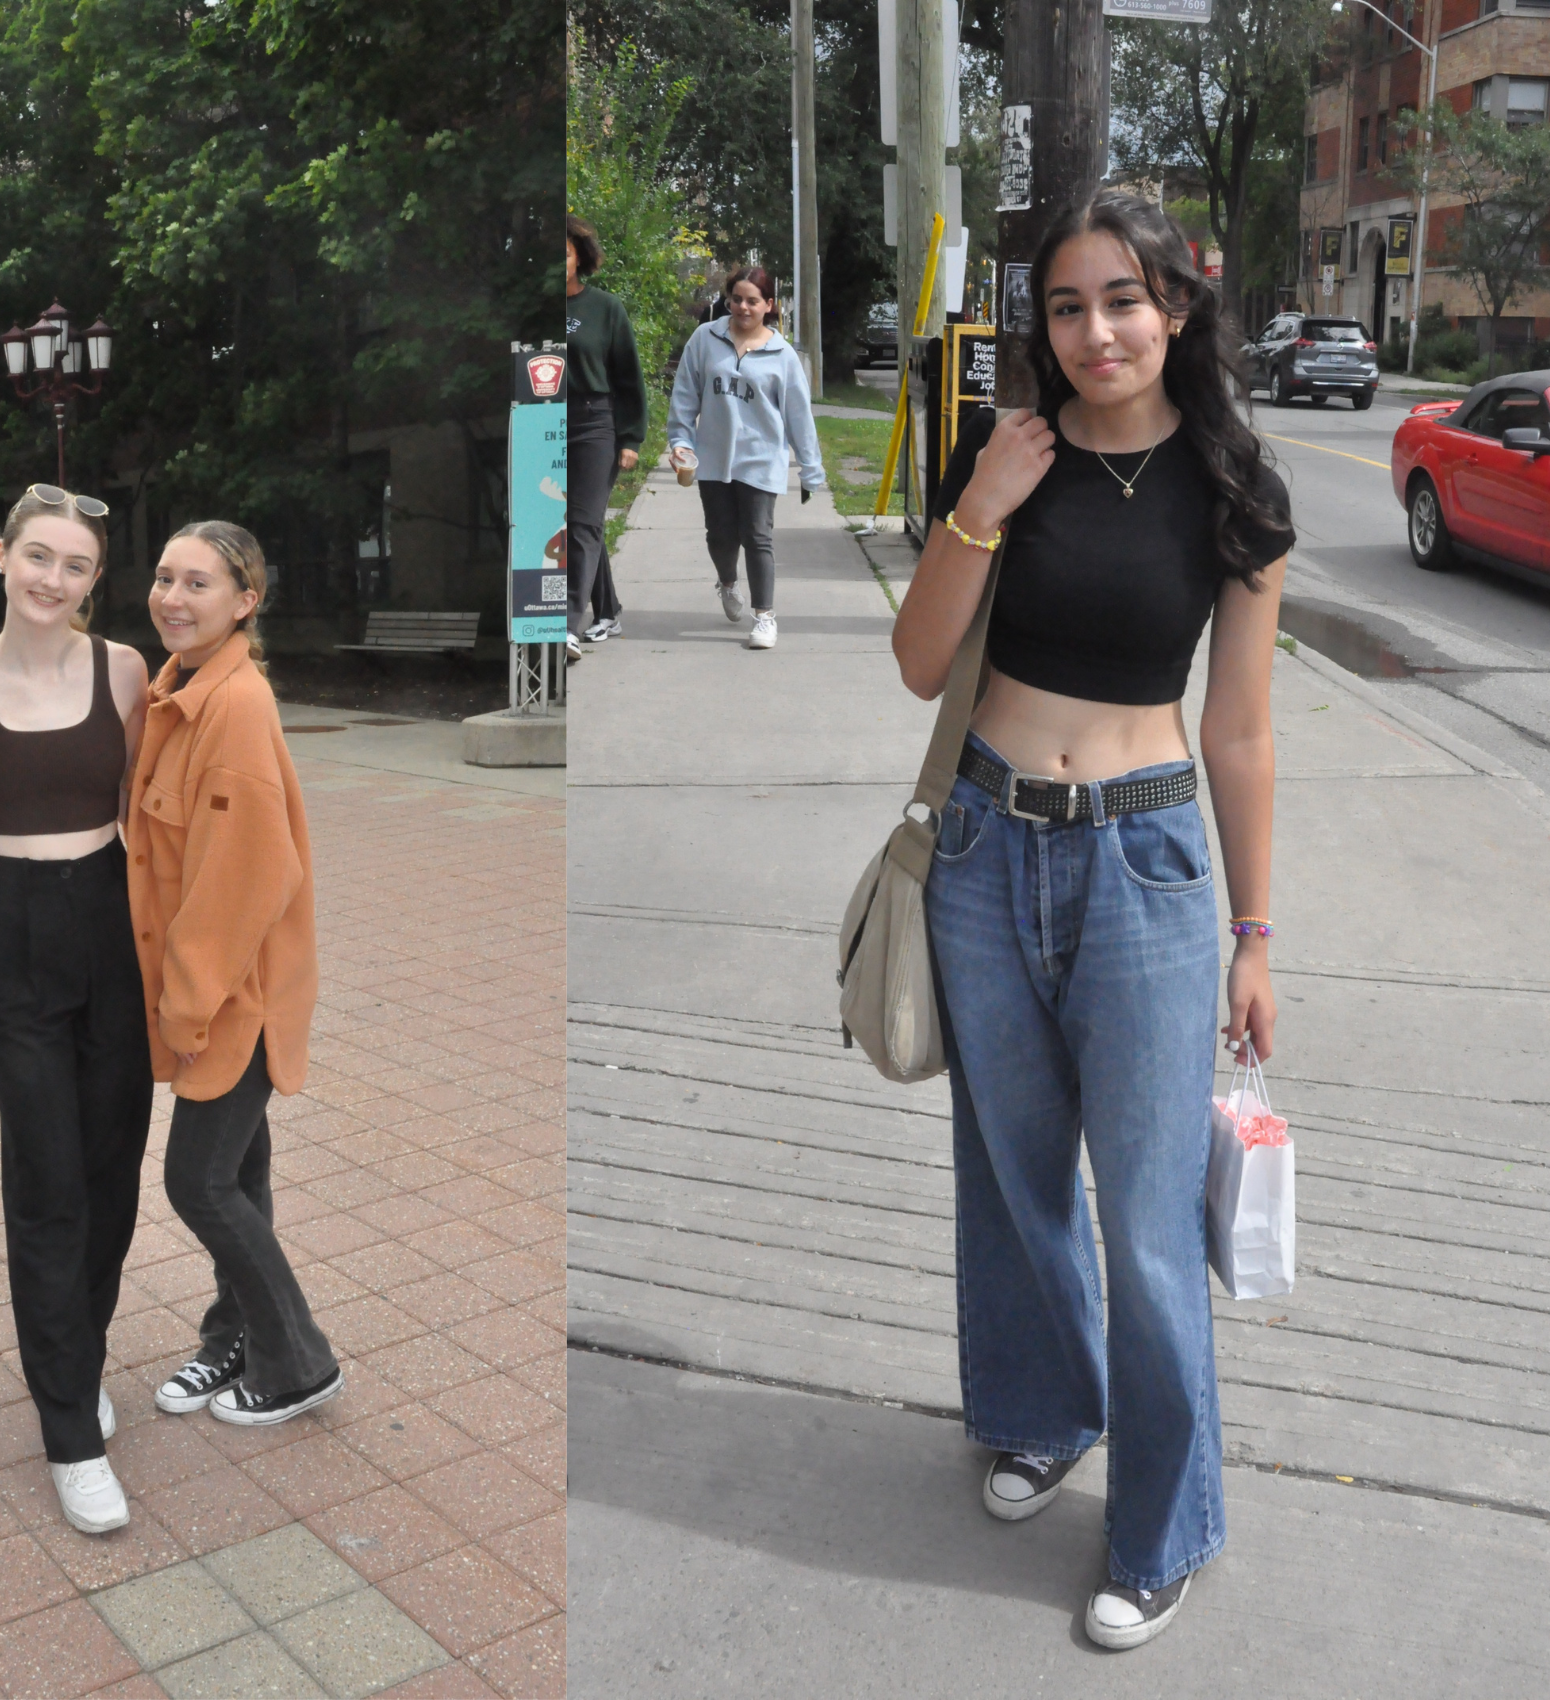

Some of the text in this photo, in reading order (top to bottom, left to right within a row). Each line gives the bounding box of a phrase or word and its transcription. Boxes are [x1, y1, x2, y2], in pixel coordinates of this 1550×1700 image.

[1127, 1, 1167, 11] 613-560-1000
[1182, 0, 1206, 10] 7609
[545, 431, 557, 441] EN
